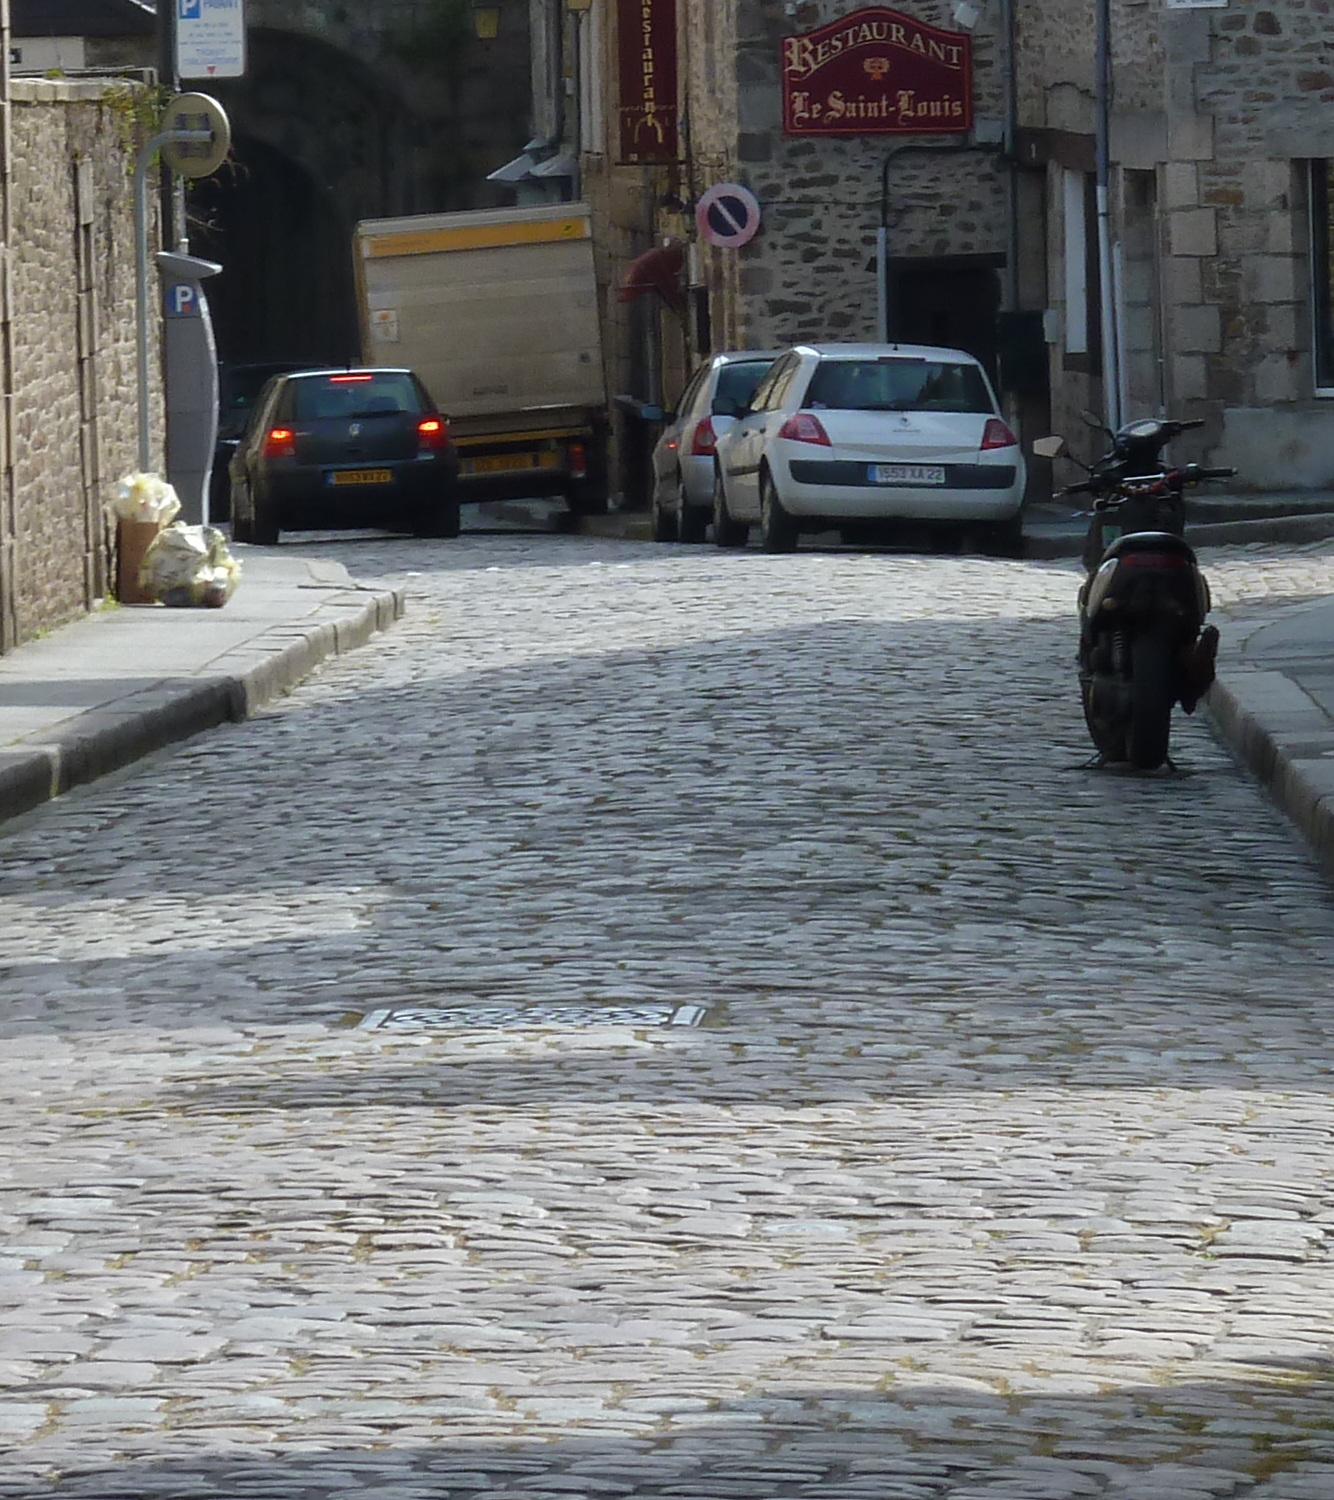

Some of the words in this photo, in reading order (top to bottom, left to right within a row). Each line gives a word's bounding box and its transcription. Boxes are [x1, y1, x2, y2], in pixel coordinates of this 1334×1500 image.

[790, 91, 822, 128] Le
[823, 90, 963, 126] Saint-Louis
[175, 285, 193, 312] P
